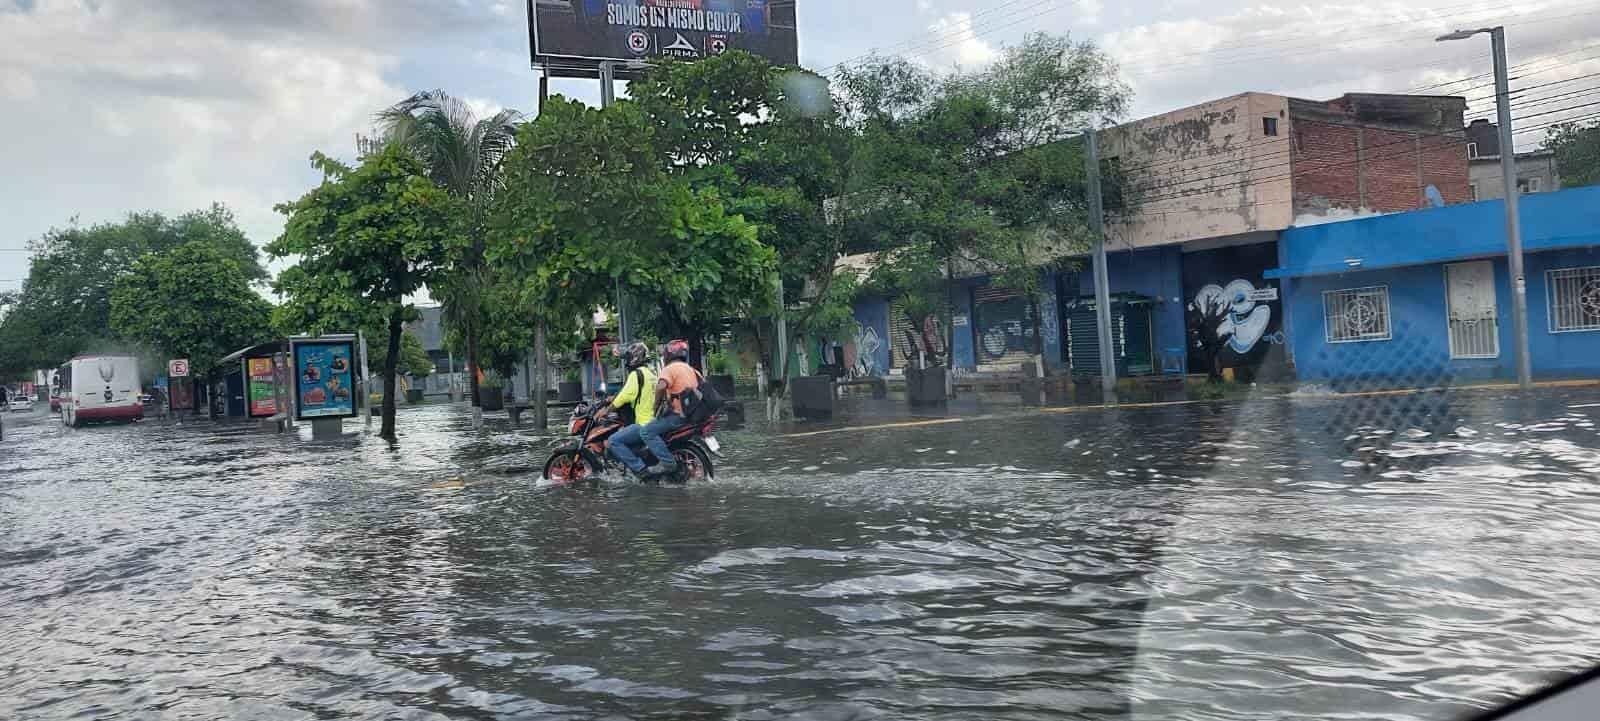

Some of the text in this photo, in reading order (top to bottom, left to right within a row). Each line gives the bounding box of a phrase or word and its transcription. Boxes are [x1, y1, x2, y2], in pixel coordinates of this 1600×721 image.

[607, 3, 742, 33] SOMOS UN MISMO COLOR
[662, 49, 699, 58] PIRMA
[175, 363, 185, 373] E
